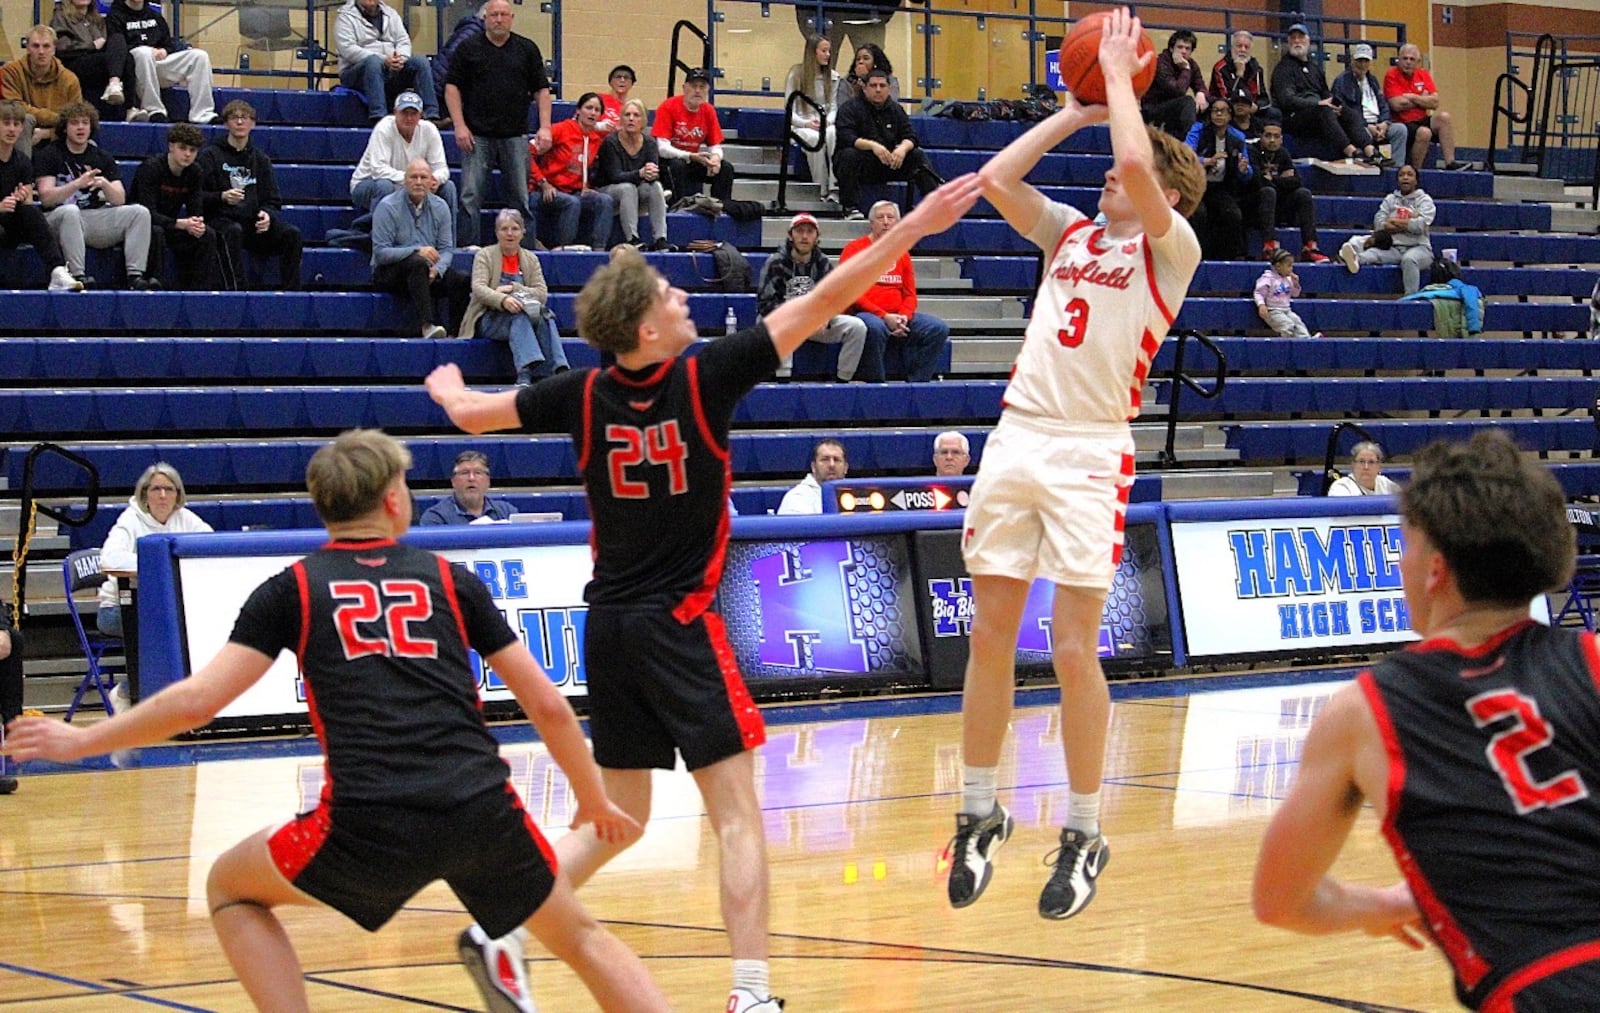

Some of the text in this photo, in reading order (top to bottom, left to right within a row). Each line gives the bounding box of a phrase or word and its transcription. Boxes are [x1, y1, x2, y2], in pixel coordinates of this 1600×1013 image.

[1050, 260, 1135, 290] airfield
[1057, 297, 1090, 349] 3
[605, 419, 689, 499] 24
[905, 491, 936, 508] POSS
[456, 559, 528, 600] RE
[1228, 525, 1403, 600] HAMIL
[328, 578, 438, 661] 22
[932, 597, 956, 626] Big
[1277, 597, 1412, 639] HIGH SCH
[1464, 687, 1590, 816] 2
